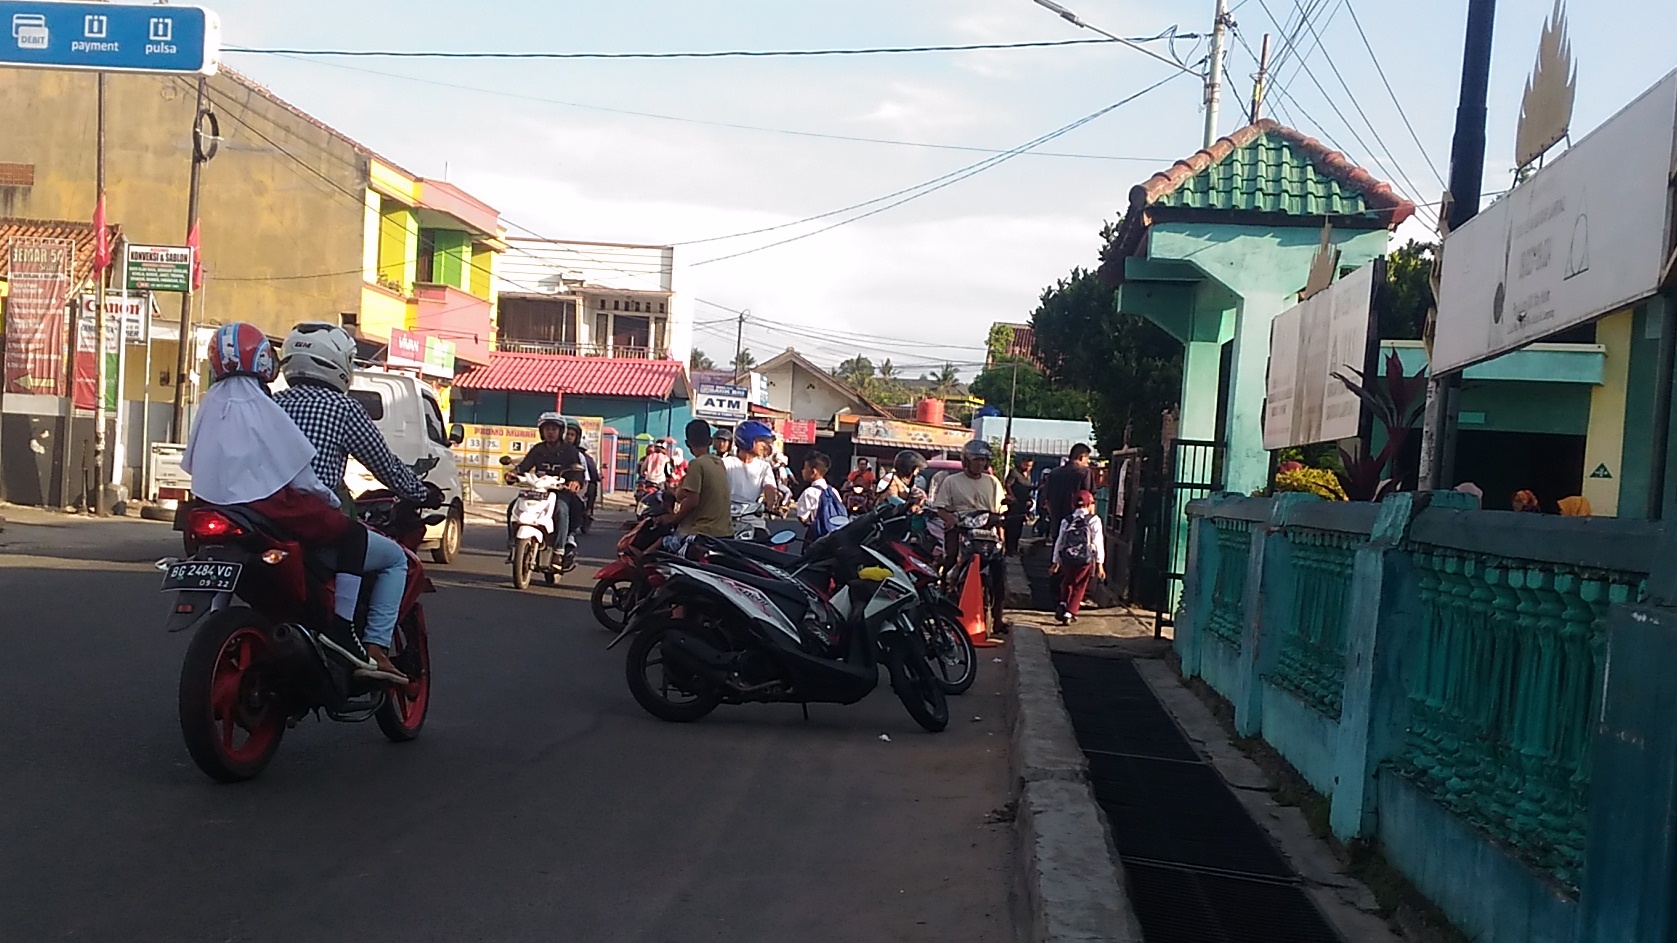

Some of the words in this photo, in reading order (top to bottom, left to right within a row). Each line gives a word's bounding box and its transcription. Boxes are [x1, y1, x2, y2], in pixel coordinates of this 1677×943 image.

[21, 35, 45, 44] DEBIT
[71, 41, 120, 53] payment
[145, 42, 177, 55] pulsa
[131, 251, 159, 261] KONVEKSI
[160, 253, 164, 262] &
[166, 253, 188, 263] SABLON
[85, 299, 140, 315] Cnon
[703, 397, 741, 409] ATM
[475, 427, 504, 436] PROMO
[506, 429, 536, 438] MURAH
[171, 565, 187, 577] BG
[187, 564, 215, 576] 2484
